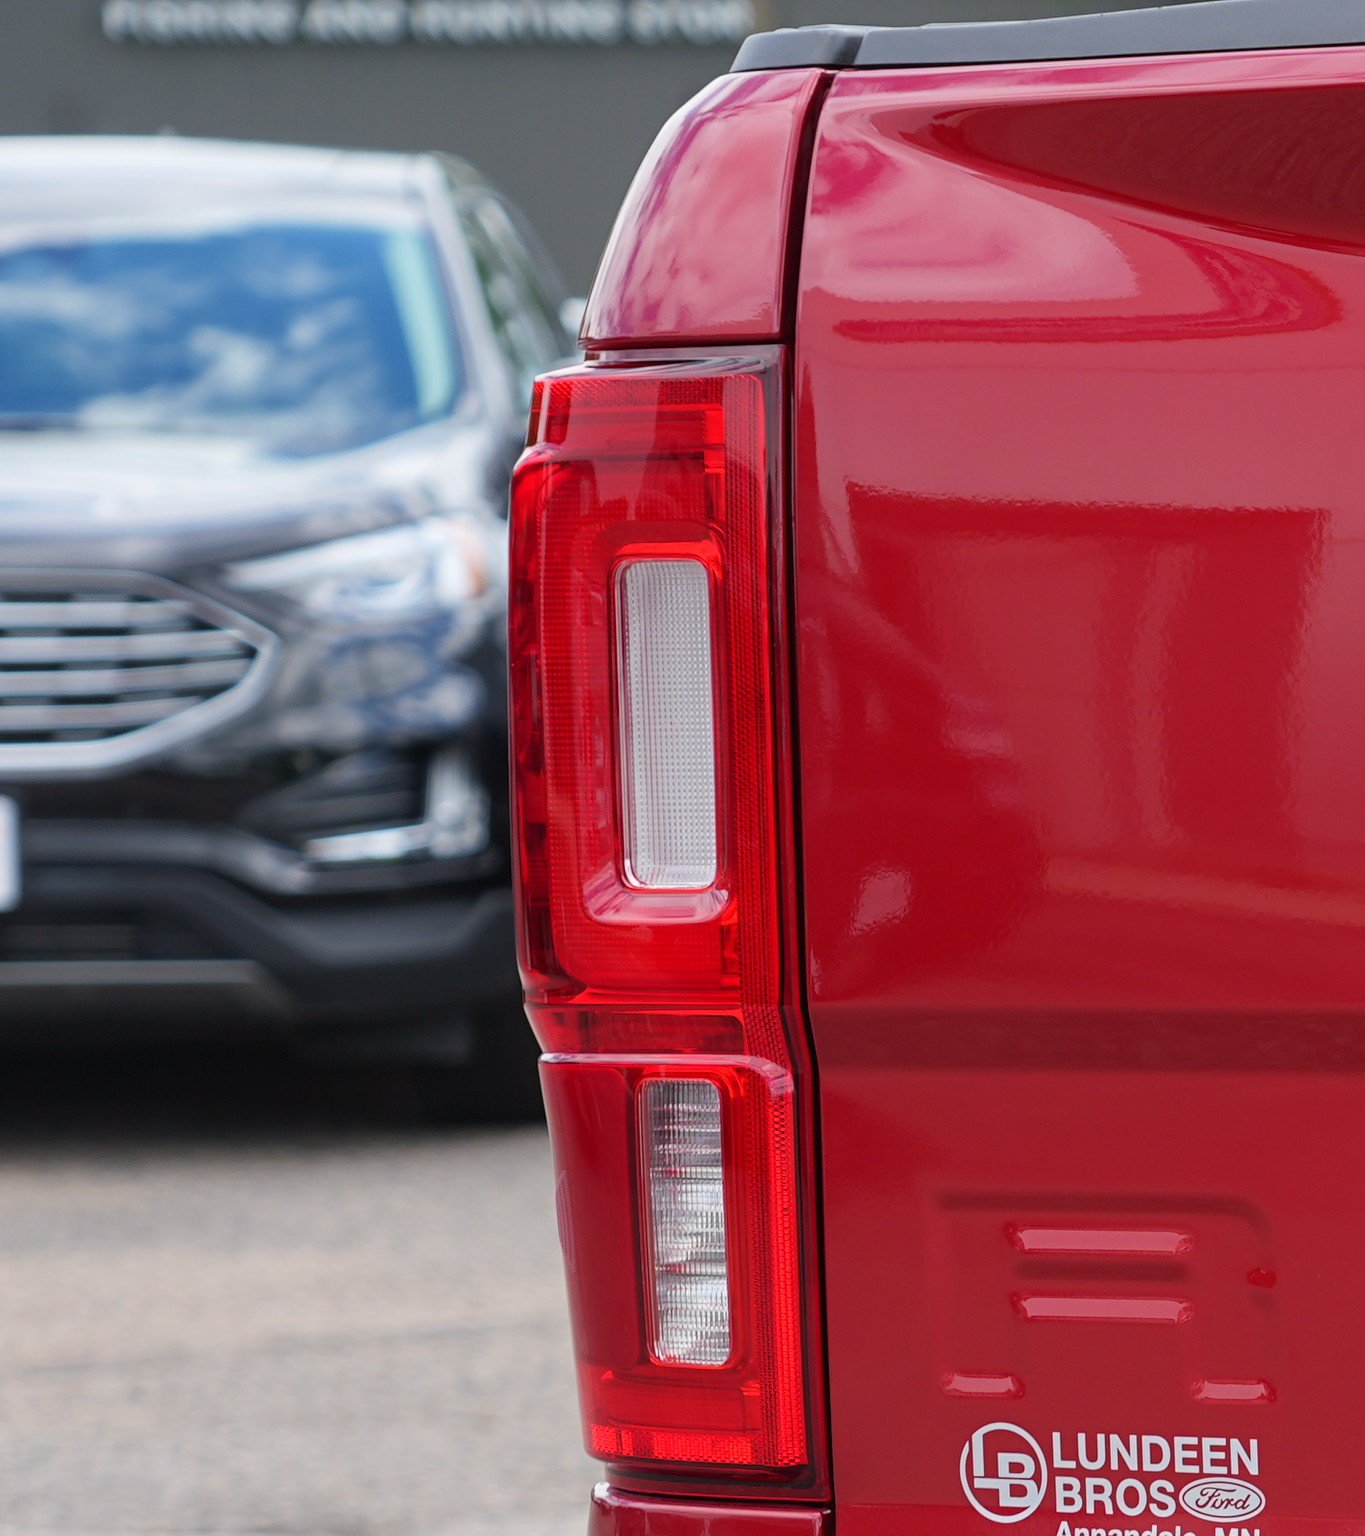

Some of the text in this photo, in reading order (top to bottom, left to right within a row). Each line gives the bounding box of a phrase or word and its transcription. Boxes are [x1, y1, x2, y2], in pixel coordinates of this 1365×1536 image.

[1052, 1431, 1259, 1476] LUNDEEN
[1055, 1476, 1251, 1517] BROS Ford
